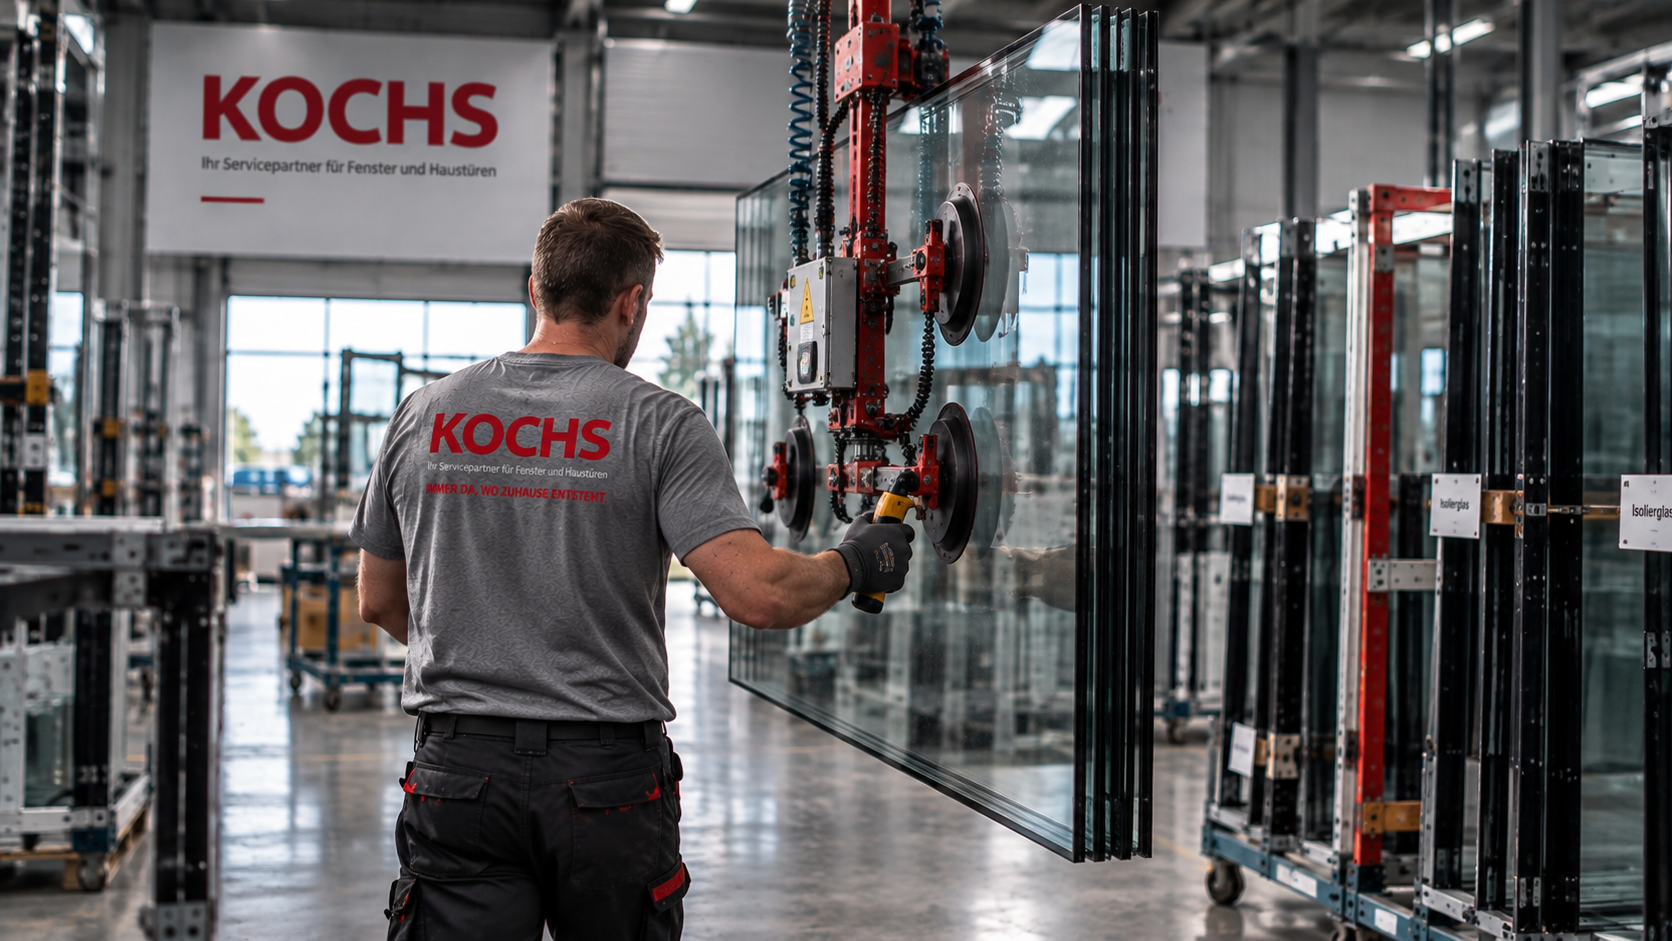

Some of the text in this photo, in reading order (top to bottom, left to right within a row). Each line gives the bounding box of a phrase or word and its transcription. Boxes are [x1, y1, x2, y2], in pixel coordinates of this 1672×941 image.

[202, 75, 498, 148] KOCHS
[201, 156, 497, 178] Ihr Servicepartner für Fenster und Haustüren
[429, 412, 612, 461] KOCHS
[427, 461, 608, 479] Ihr Servicepartner für Fenster und Haustüren
[426, 482, 458, 494] IMMER
[460, 484, 479, 496] DA,
[480, 485, 499, 496] WO
[500, 486, 549, 499] ZUHAUSE
[1440, 498, 1470, 512] Isolierglas
